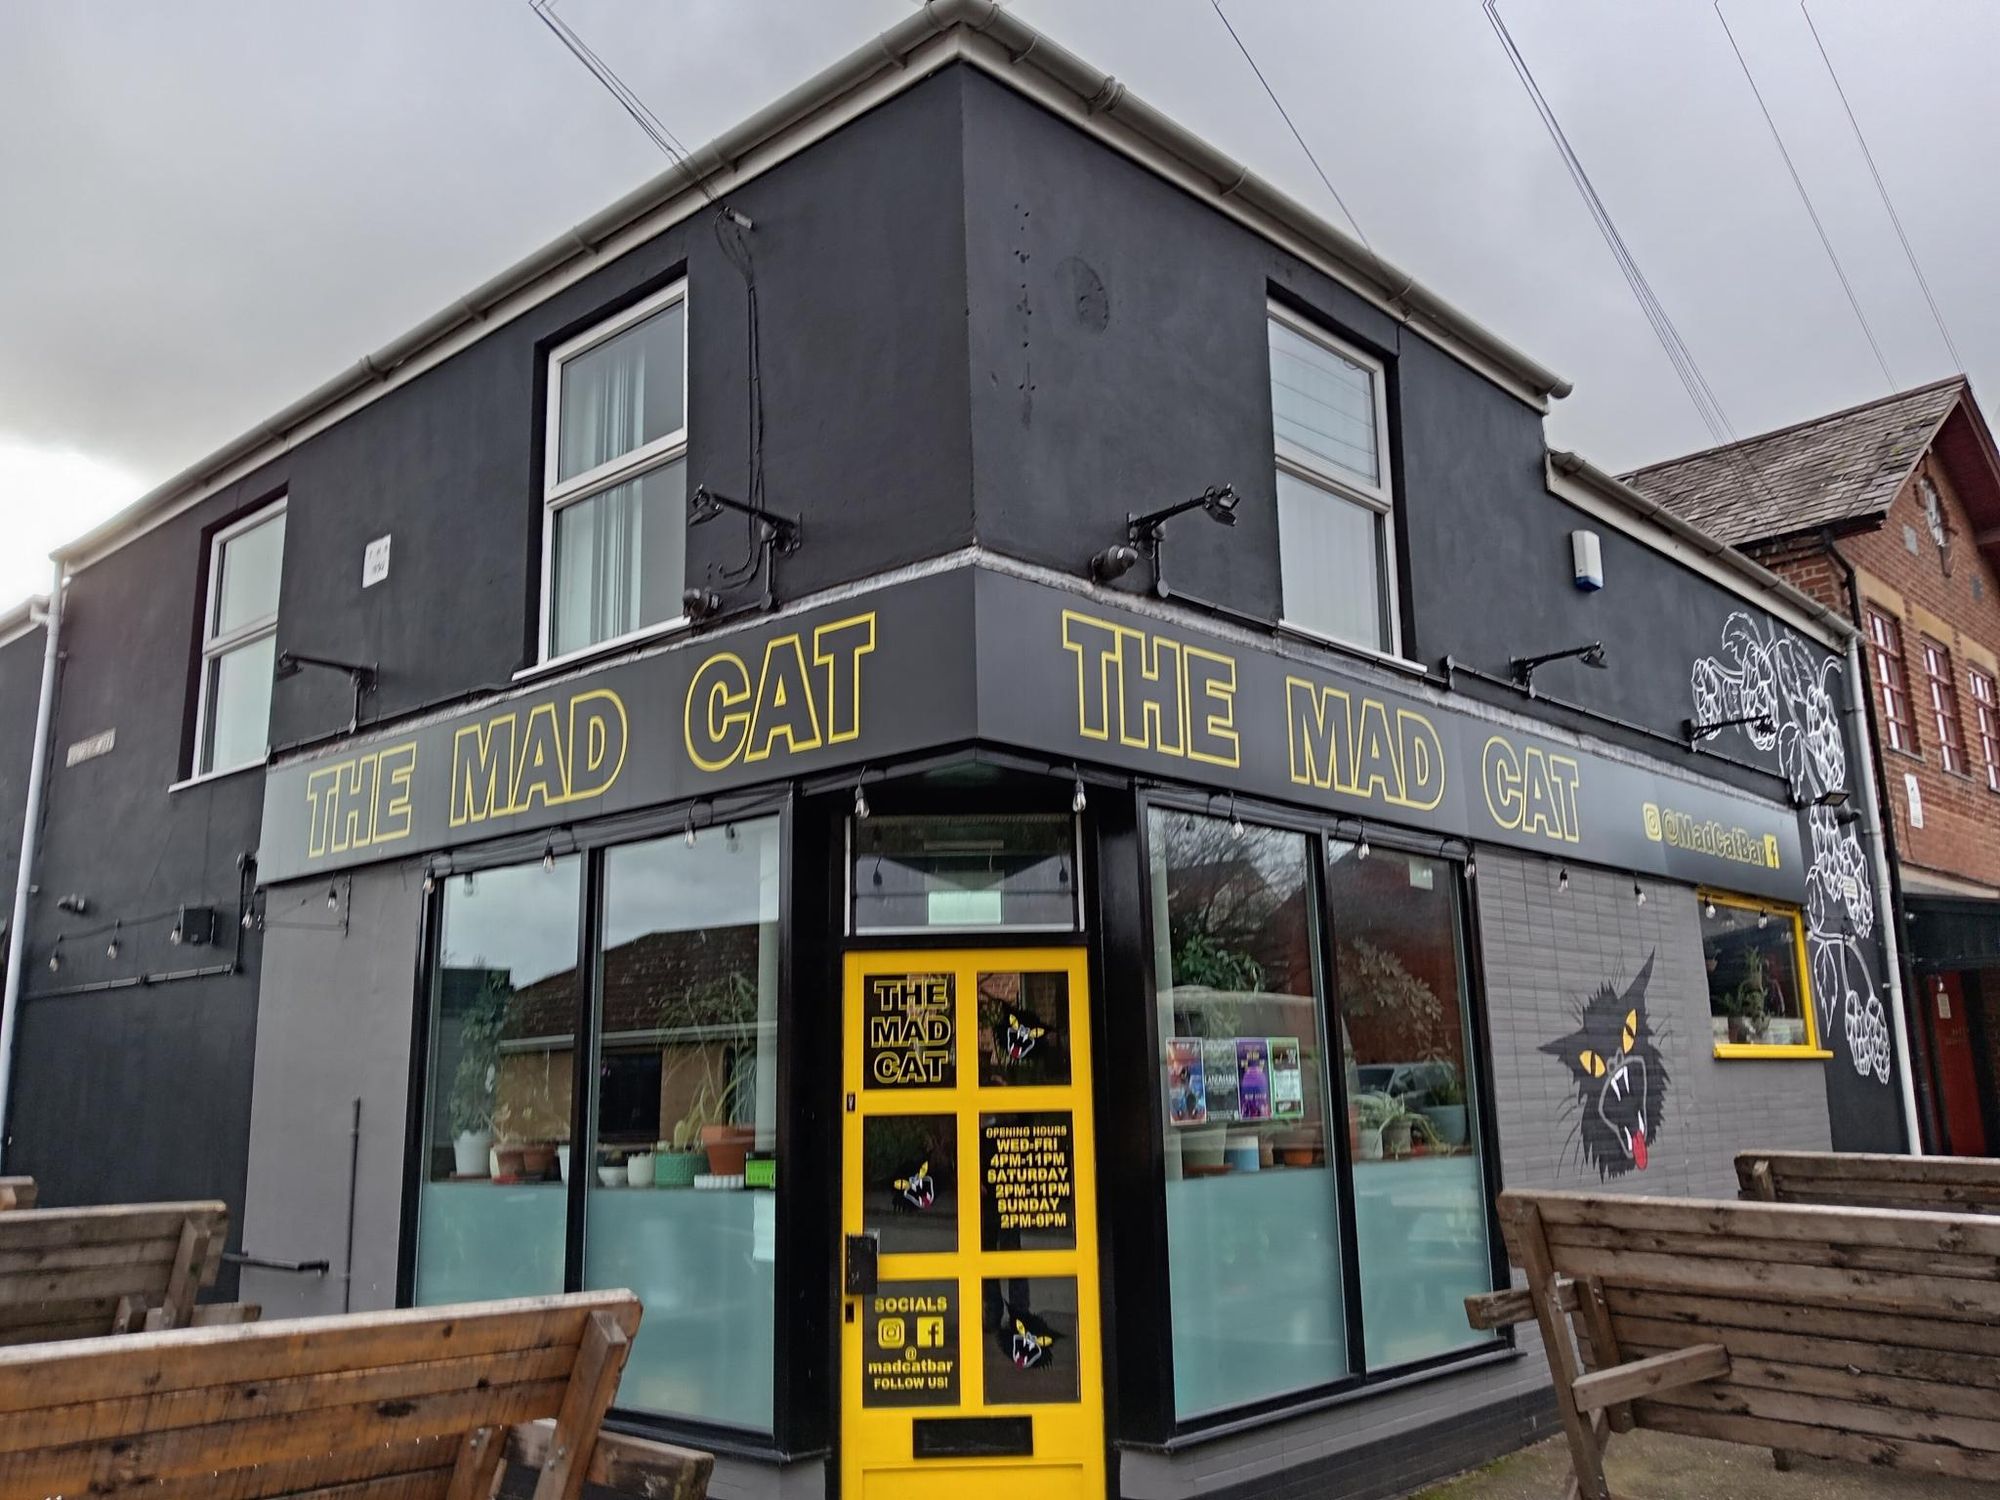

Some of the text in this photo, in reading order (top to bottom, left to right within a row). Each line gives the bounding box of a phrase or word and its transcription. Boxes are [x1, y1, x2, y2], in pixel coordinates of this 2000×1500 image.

[1062, 609, 1580, 843] THE MAD CAT
[306, 611, 876, 859] THE MAD CAT
[1662, 808, 1765, 867] @MadCatBar
[874, 979, 948, 1012] THE
[871, 1014, 951, 1048] MAD
[874, 1050, 948, 1084] CAT
[986, 1125, 1067, 1139] OPENING HOURS
[996, 1137, 1058, 1152] WED-FRI
[990, 1152, 1065, 1168] 4PM-11PM
[987, 1167, 1068, 1184] SATURDAY
[995, 1182, 1070, 1198] 2PM-11PM
[997, 1197, 1060, 1213] SUNDAY
[874, 1296, 948, 1313] SOCIALS
[868, 1359, 953, 1375] madcatbar
[874, 1376, 948, 1391] FOLLOW US!
